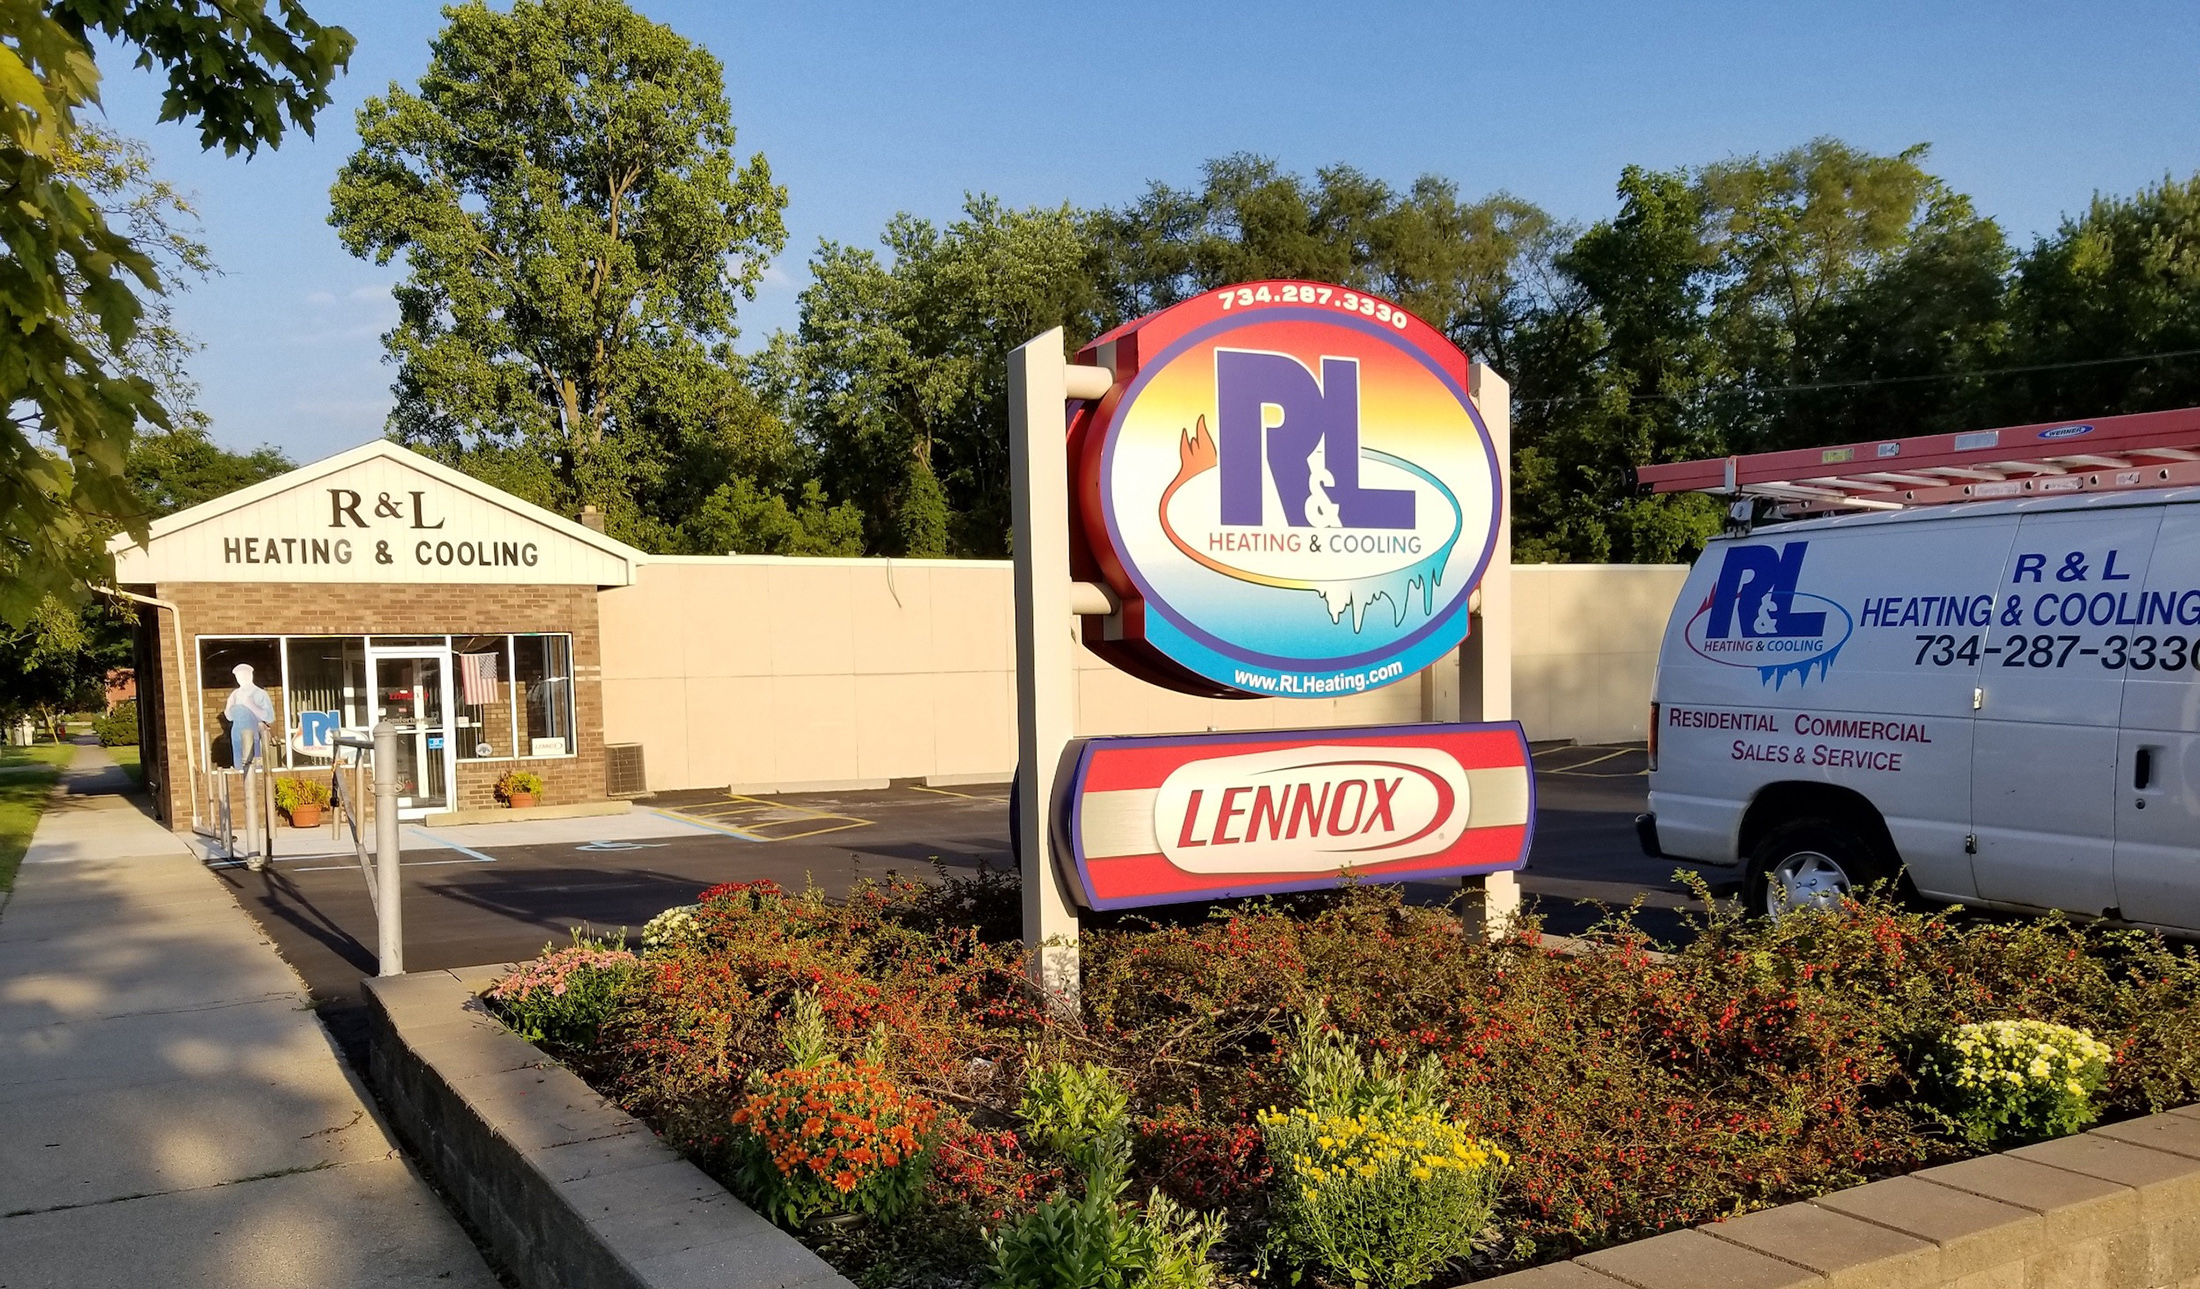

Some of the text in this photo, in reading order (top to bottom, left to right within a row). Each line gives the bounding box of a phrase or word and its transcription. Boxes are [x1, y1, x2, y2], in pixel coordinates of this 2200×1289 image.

[1218, 284, 1407, 330] 734.287.3330
[2047, 426, 2084, 437] WERNER
[223, 537, 538, 567] HEATING & COOLING
[1209, 532, 1422, 554] HEATING & COOLING
[2012, 549, 2131, 583] R & L
[1860, 589, 2200, 628] HEATING & COOLING
[1704, 640, 1824, 652] HEATING & COOLING
[1234, 660, 1403, 692] www.RLHeating.com
[1669, 707, 1932, 743] RESIDENTIAL COMMERCIAL
[1731, 739, 1903, 772] SALES & SERVICE
[1177, 777, 1404, 849] LENNOX
